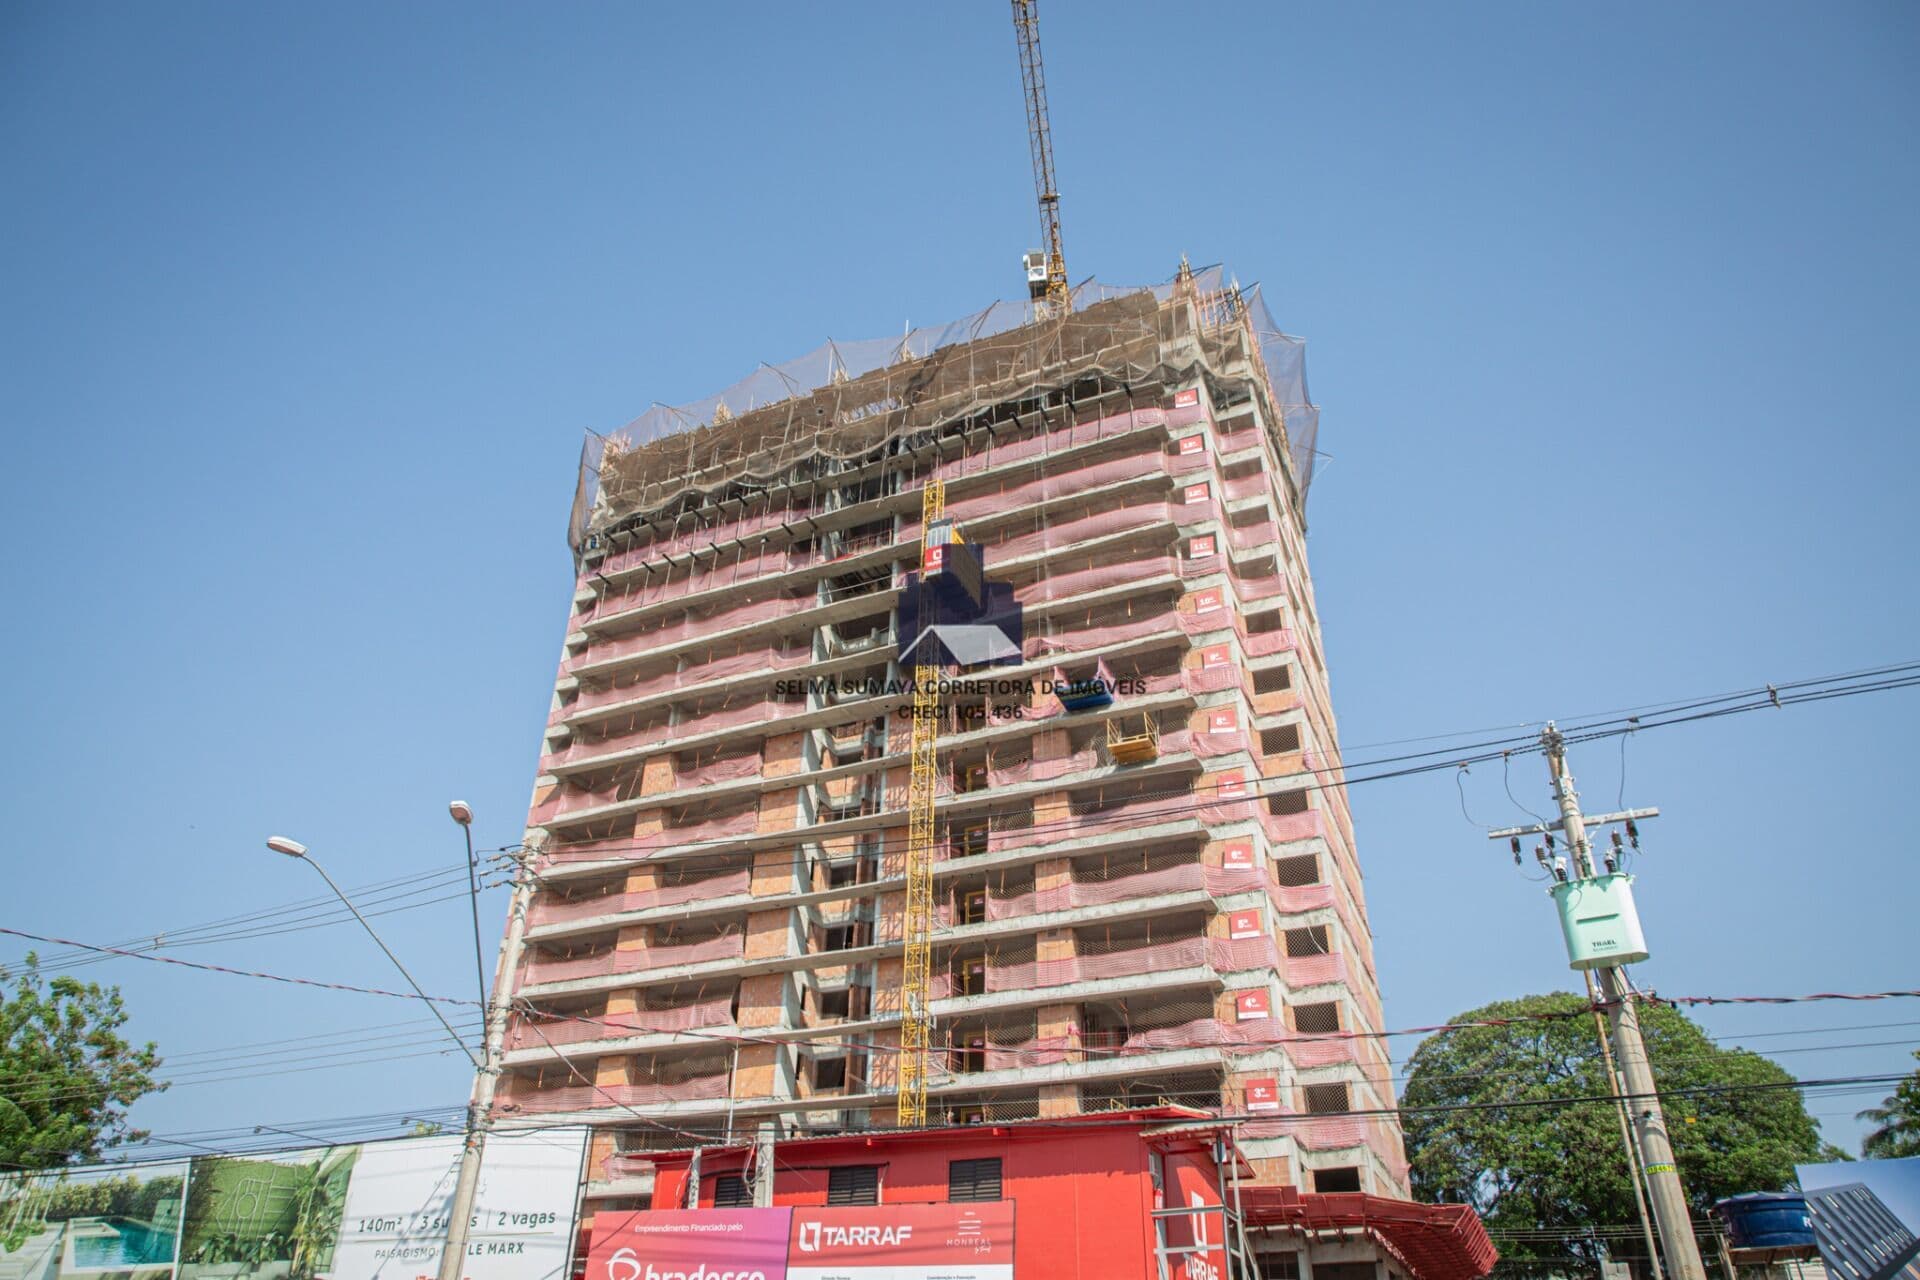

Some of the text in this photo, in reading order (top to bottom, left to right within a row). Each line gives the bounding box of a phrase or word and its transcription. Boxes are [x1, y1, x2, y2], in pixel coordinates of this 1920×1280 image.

[358, 1217, 402, 1233] 140m²
[420, 1216, 429, 1230] 3
[498, 1212, 507, 1226] 2
[512, 1212, 556, 1228] vagas
[690, 1223, 726, 1232] Financiado
[727, 1223, 743, 1232] pelo
[823, 1226, 913, 1246] TARRAF
[487, 1243, 525, 1255] MARX
